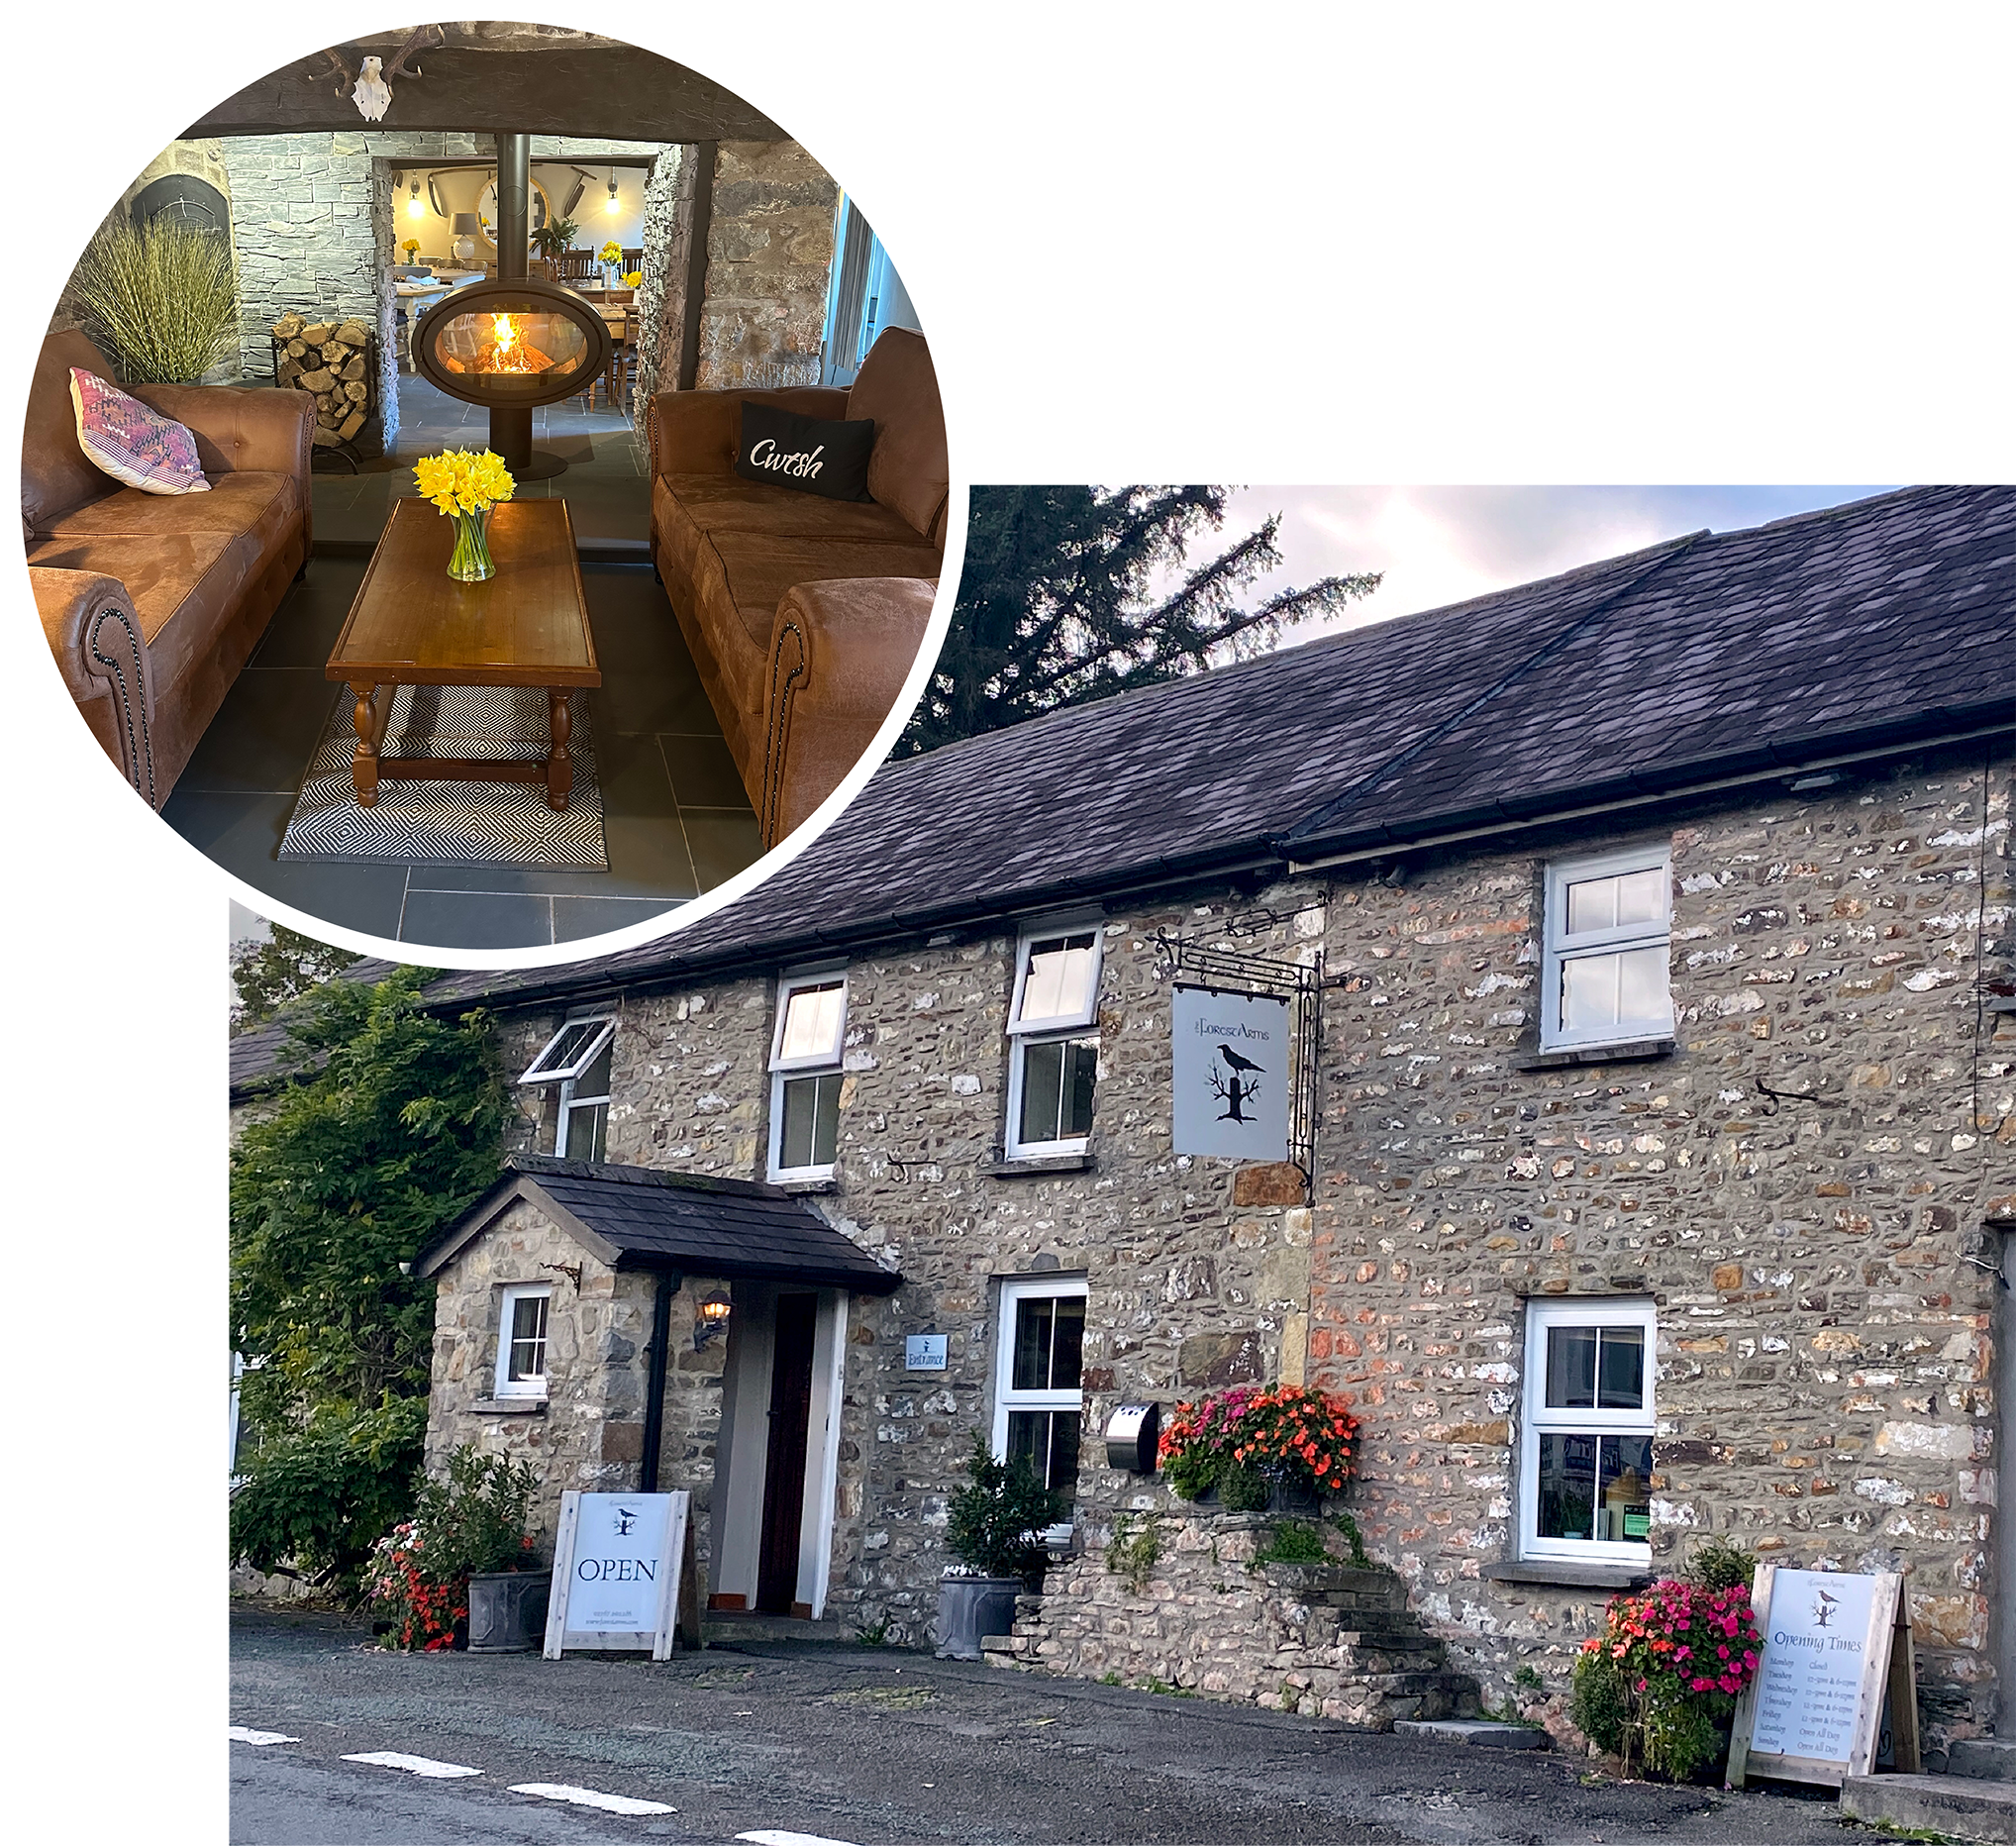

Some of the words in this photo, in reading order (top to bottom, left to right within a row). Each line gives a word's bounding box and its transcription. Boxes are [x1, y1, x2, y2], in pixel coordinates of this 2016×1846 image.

[750, 439, 825, 479] Cwtsh
[1238, 1022, 1270, 1041] Arms
[908, 1353, 944, 1366] Entrance
[578, 1558, 658, 1582] OPEN
[1774, 1631, 1825, 1654] Opening
[1827, 1635, 1863, 1653] Times
[1769, 1657, 1794, 1668] Monday
[1768, 1670, 1792, 1681] Tuesday
[1764, 1694, 1792, 1708] Thursday
[1762, 1709, 1781, 1721] Friday
[1799, 1727, 1816, 1738] Open
[1816, 1727, 1827, 1738] All
[1827, 1731, 1841, 1742] Day
[1758, 1736, 1779, 1747] Sunday
[1797, 1741, 1814, 1752] Open
[1814, 1741, 1825, 1752] All
[1825, 1745, 1839, 1756] Day
